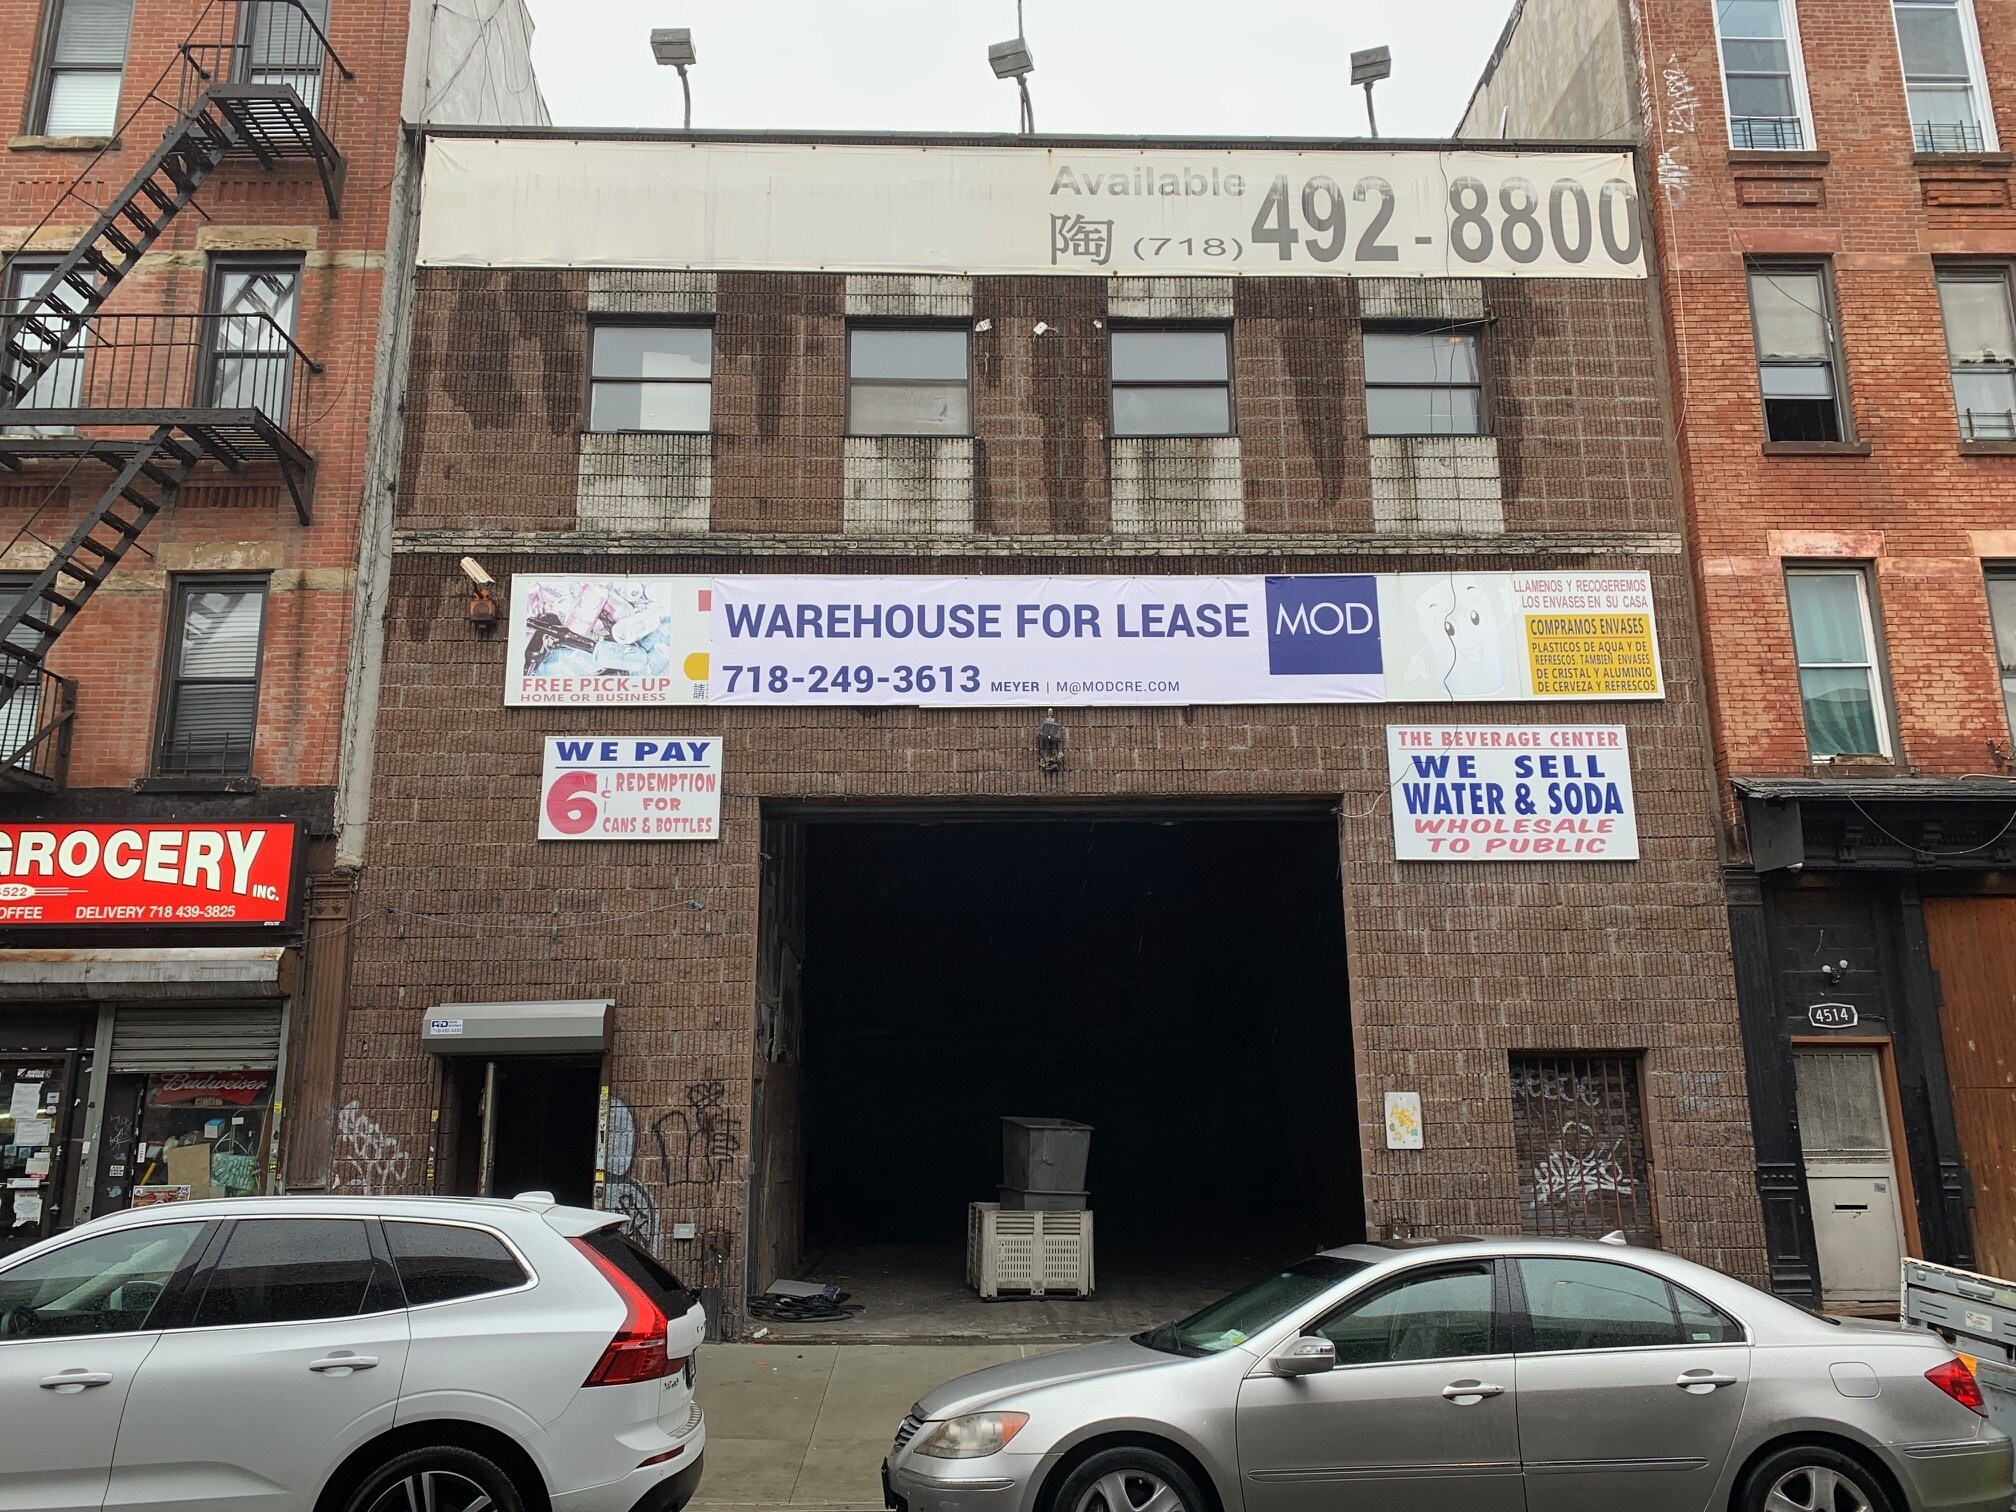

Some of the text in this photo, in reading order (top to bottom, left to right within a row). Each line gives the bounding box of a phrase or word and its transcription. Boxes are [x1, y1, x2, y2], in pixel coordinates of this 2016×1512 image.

[1050, 166, 1246, 196] Available
[1050, 213, 1115, 265] 陶
[1133, 237, 1243, 261] (718)
[1514, 579, 1646, 593] LLAMENOS Y RECOGEREMOS
[1522, 595, 1648, 608] LOS ENVASES EN SU CASA
[725, 604, 1249, 638] WAREHOUSE FOR LEASE
[1275, 602, 1373, 635] MOD
[1531, 618, 1643, 635] COMPRAMOS ENVASES
[1532, 642, 1647, 654] PLASTICOS DE AQUA Y DE
[1618, 654, 1650, 665] ENVASES
[723, 665, 980, 693] 718-249-3613
[1537, 667, 1652, 679] DE CRISTAL Y ALUMINIO
[522, 678, 670, 692] FREE PICK-UP
[991, 681, 1039, 692] MEYER
[1056, 681, 1179, 695] M@MODCRE.COM
[1538, 680, 1655, 692] DE CERVEZA Y REFRESCOS
[521, 694, 564, 702] HOME
[1399, 731, 1619, 747] THE BEVERAGE CENTER
[556, 742, 710, 761] WE PAY
[1412, 755, 1605, 778] WE SELL
[616, 773, 716, 792] REDEMPTION
[643, 798, 681, 811] FOR
[1403, 782, 1624, 814] WATER & SODA
[603, 817, 712, 833] CANS & BOTTLES
[1414, 819, 1615, 834] WHOLESALE
[1426, 837, 1606, 854] TO PUBLIC
[0, 887, 27, 896] 522
[252, 884, 280, 901] INC.
[76, 906, 235, 919] DELIVERY 718 439-3825
[1816, 1008, 1849, 1022] 4514
[161, 1073, 269, 1091] Budweiser
